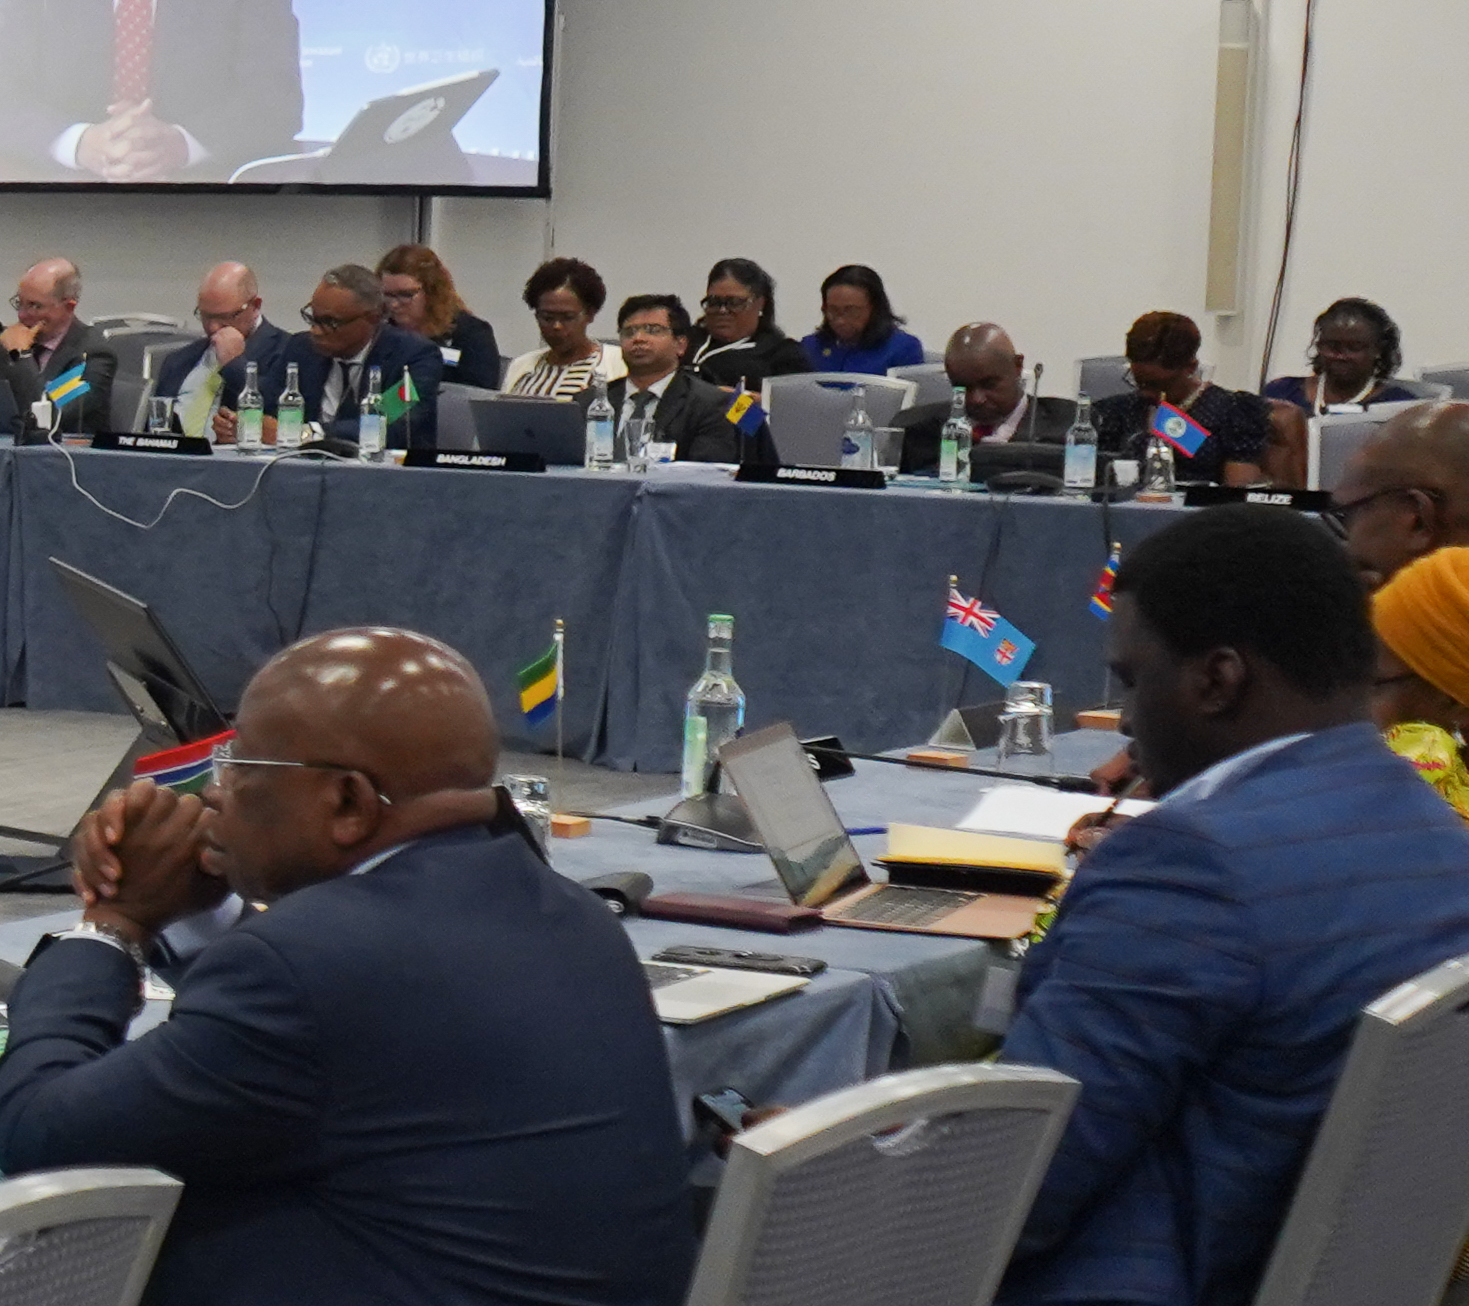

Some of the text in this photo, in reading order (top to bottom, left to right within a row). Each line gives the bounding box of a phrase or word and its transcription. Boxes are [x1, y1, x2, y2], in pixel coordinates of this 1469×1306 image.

[118, 435, 136, 446] THE
[436, 453, 506, 467] BANGLADESH
[776, 467, 837, 483] BARBADOS
